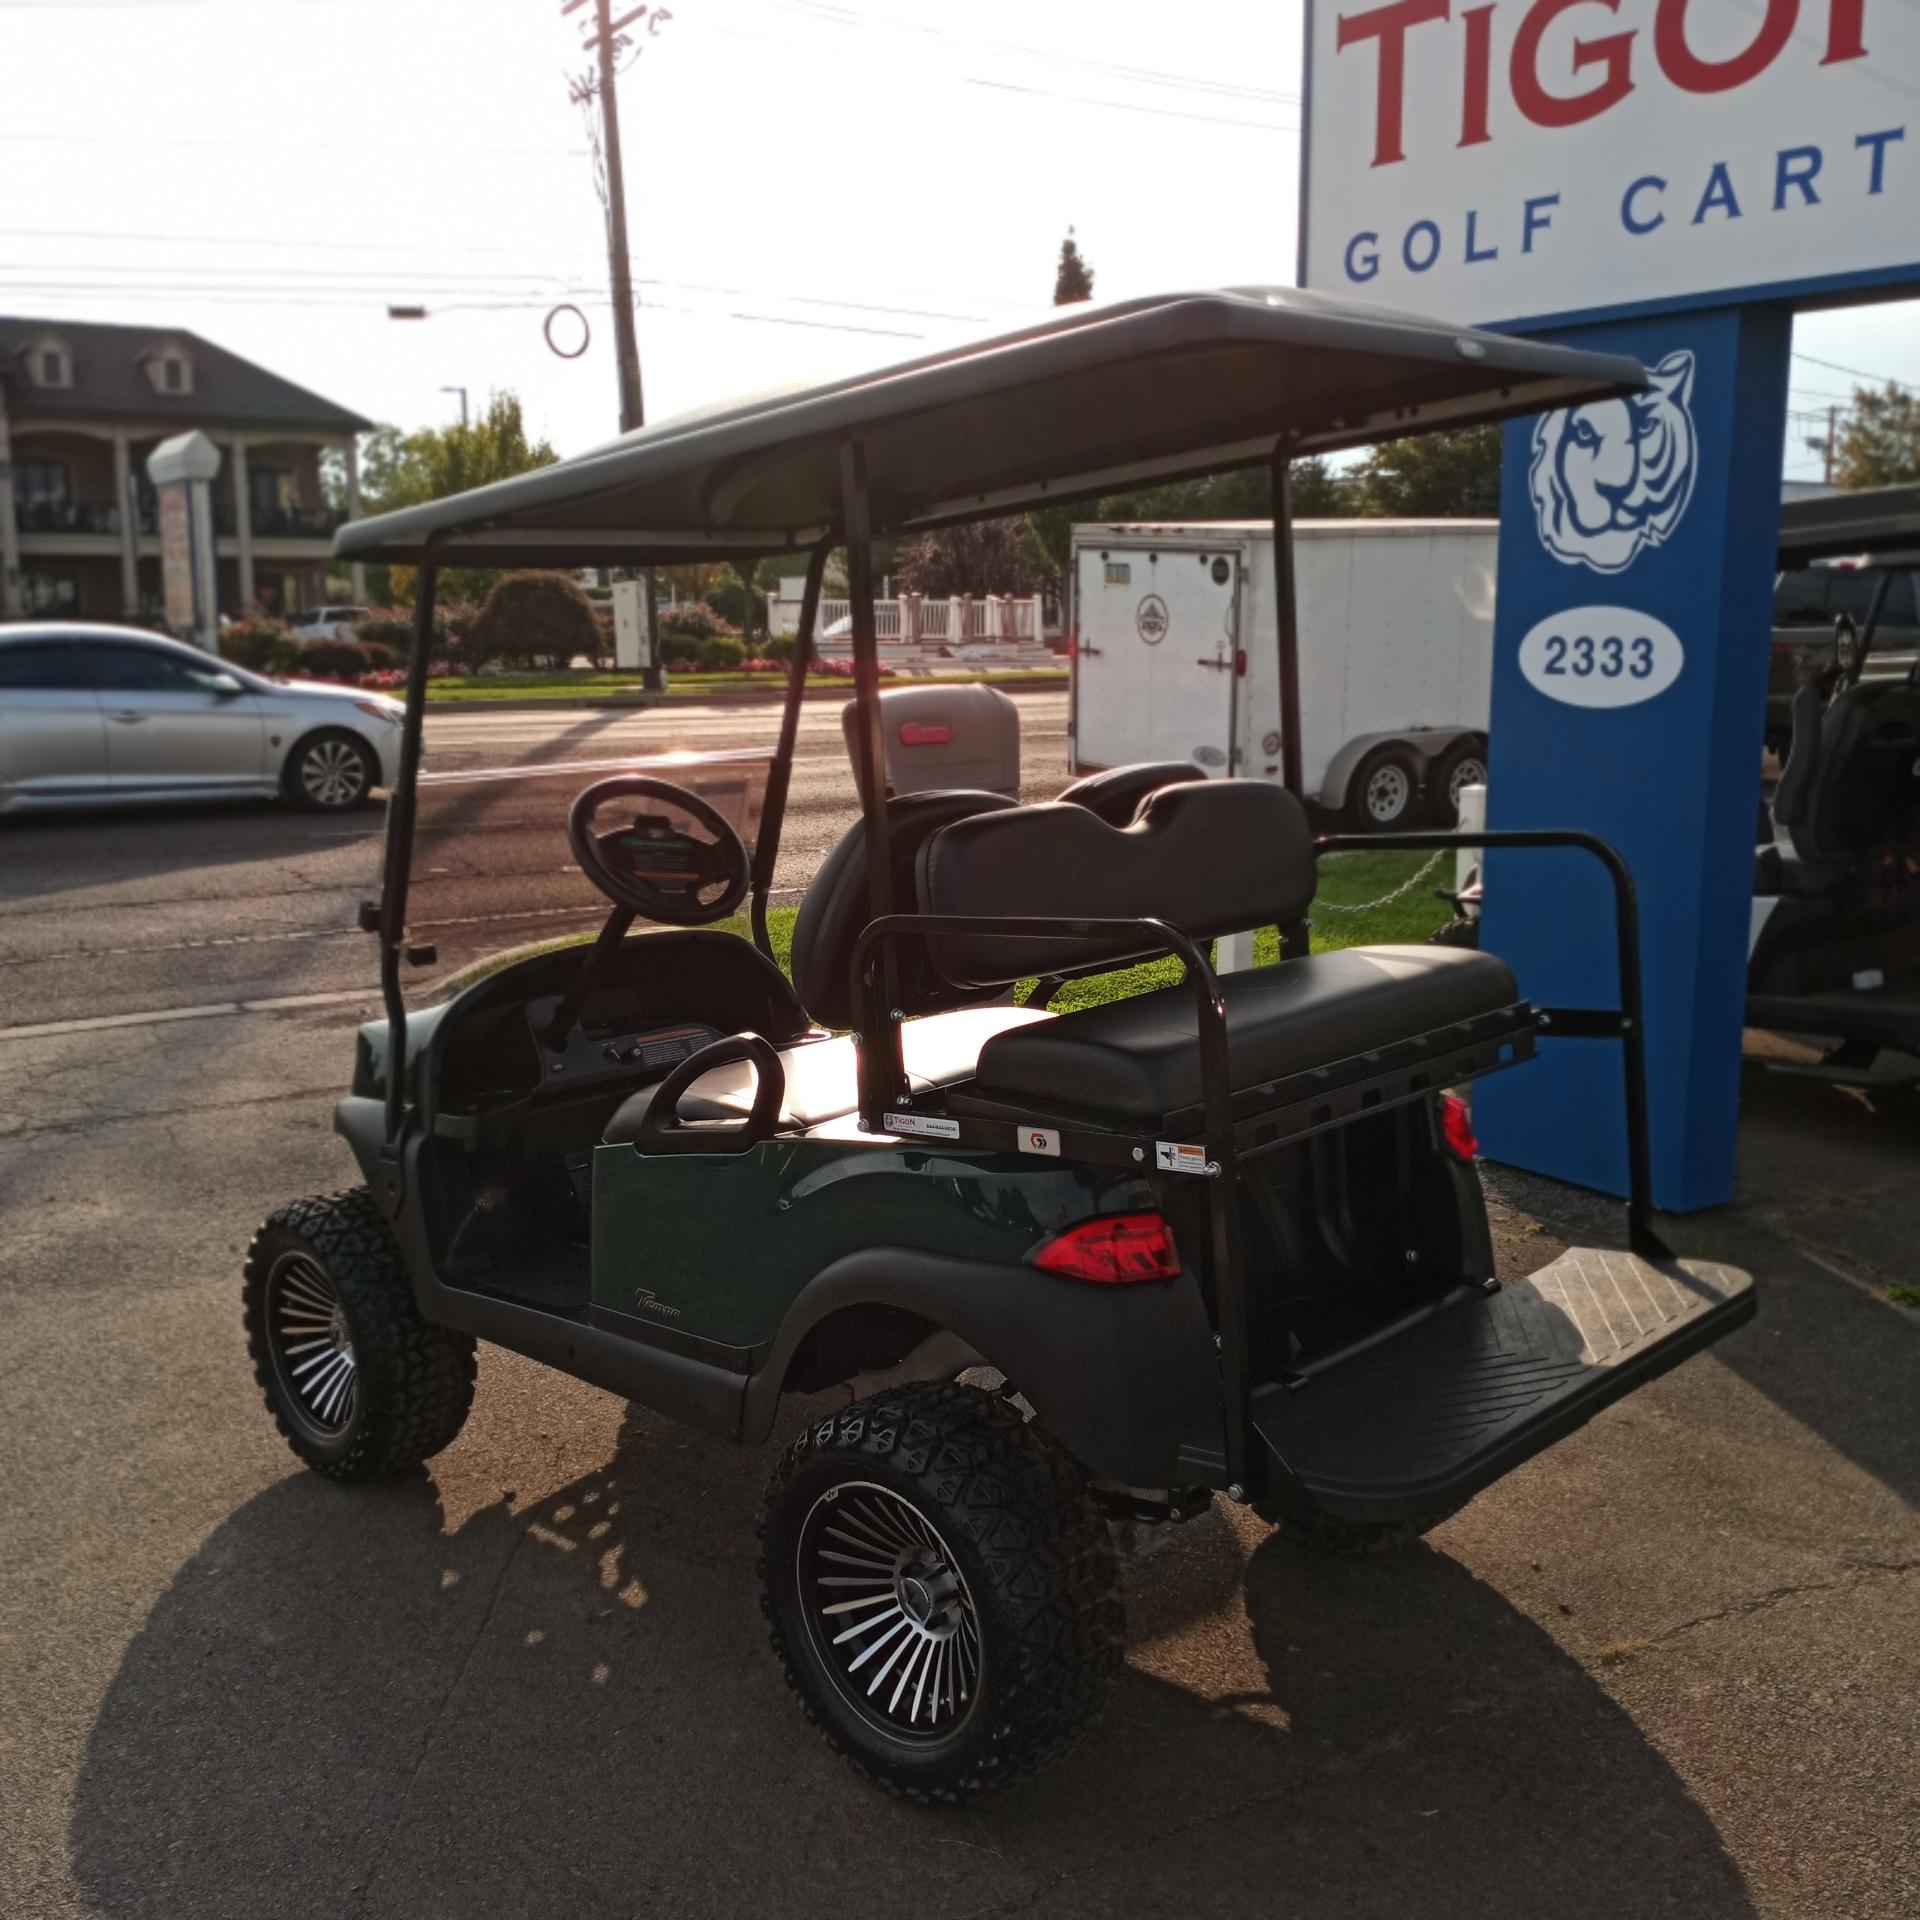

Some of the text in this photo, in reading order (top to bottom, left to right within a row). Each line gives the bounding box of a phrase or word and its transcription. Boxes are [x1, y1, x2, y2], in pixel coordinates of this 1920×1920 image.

[1343, 126, 1906, 283] GOLF CART
[1543, 635, 1655, 679] 2333
